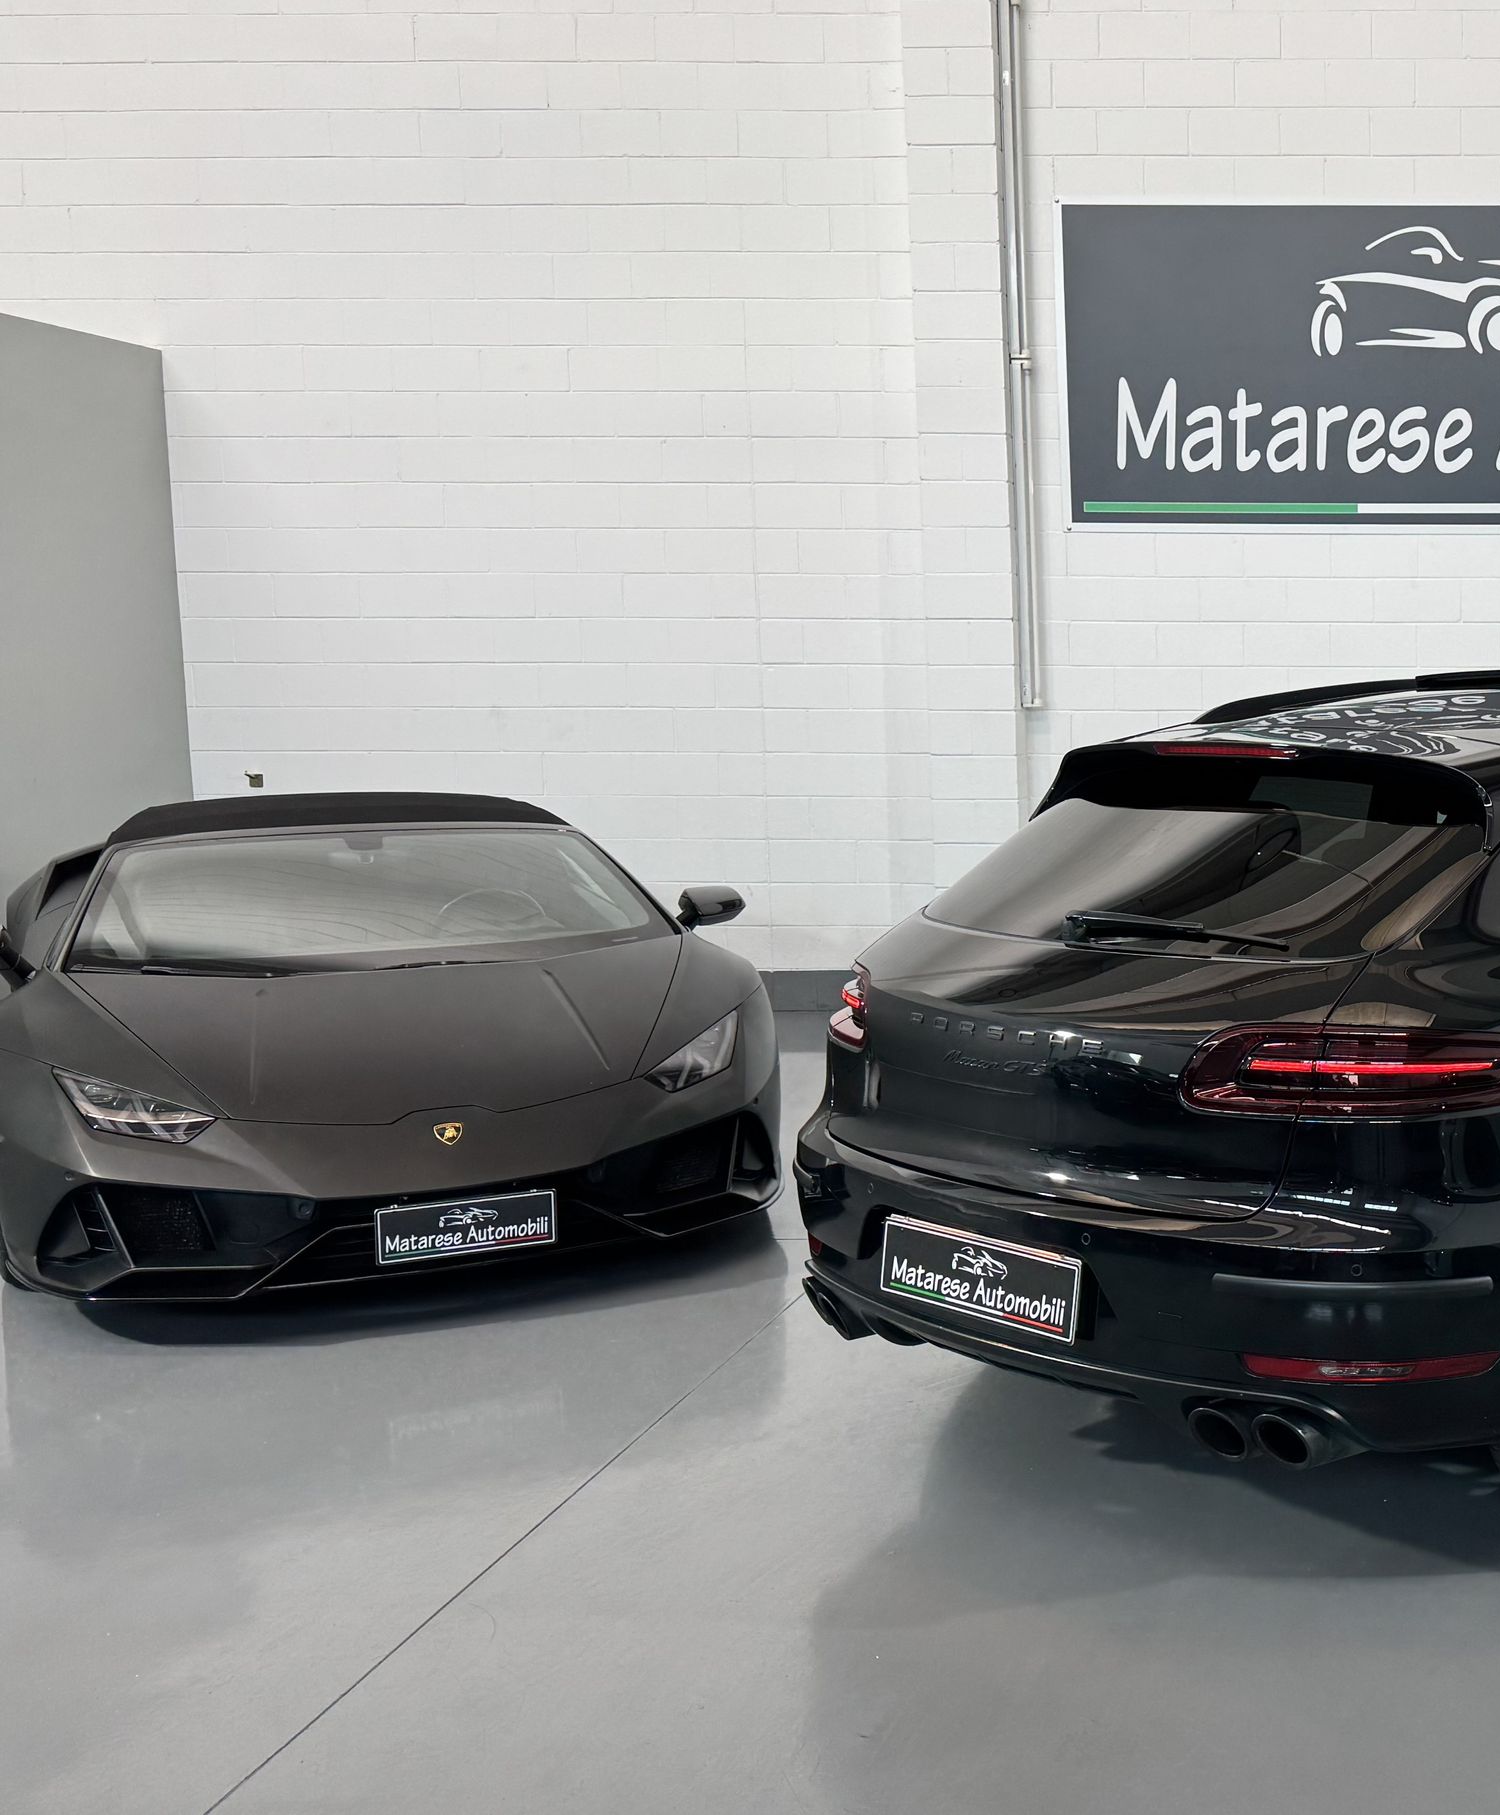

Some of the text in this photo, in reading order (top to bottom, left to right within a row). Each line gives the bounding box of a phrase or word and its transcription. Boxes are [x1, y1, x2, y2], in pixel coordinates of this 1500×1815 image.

[1117, 376, 1473, 475] Matarese
[911, 1012, 1104, 1054] PORSCHE
[943, 1050, 1000, 1069] Macan
[386, 1217, 549, 1253] Matarese Automobili
[891, 1256, 1066, 1326] Matarese Automobili
